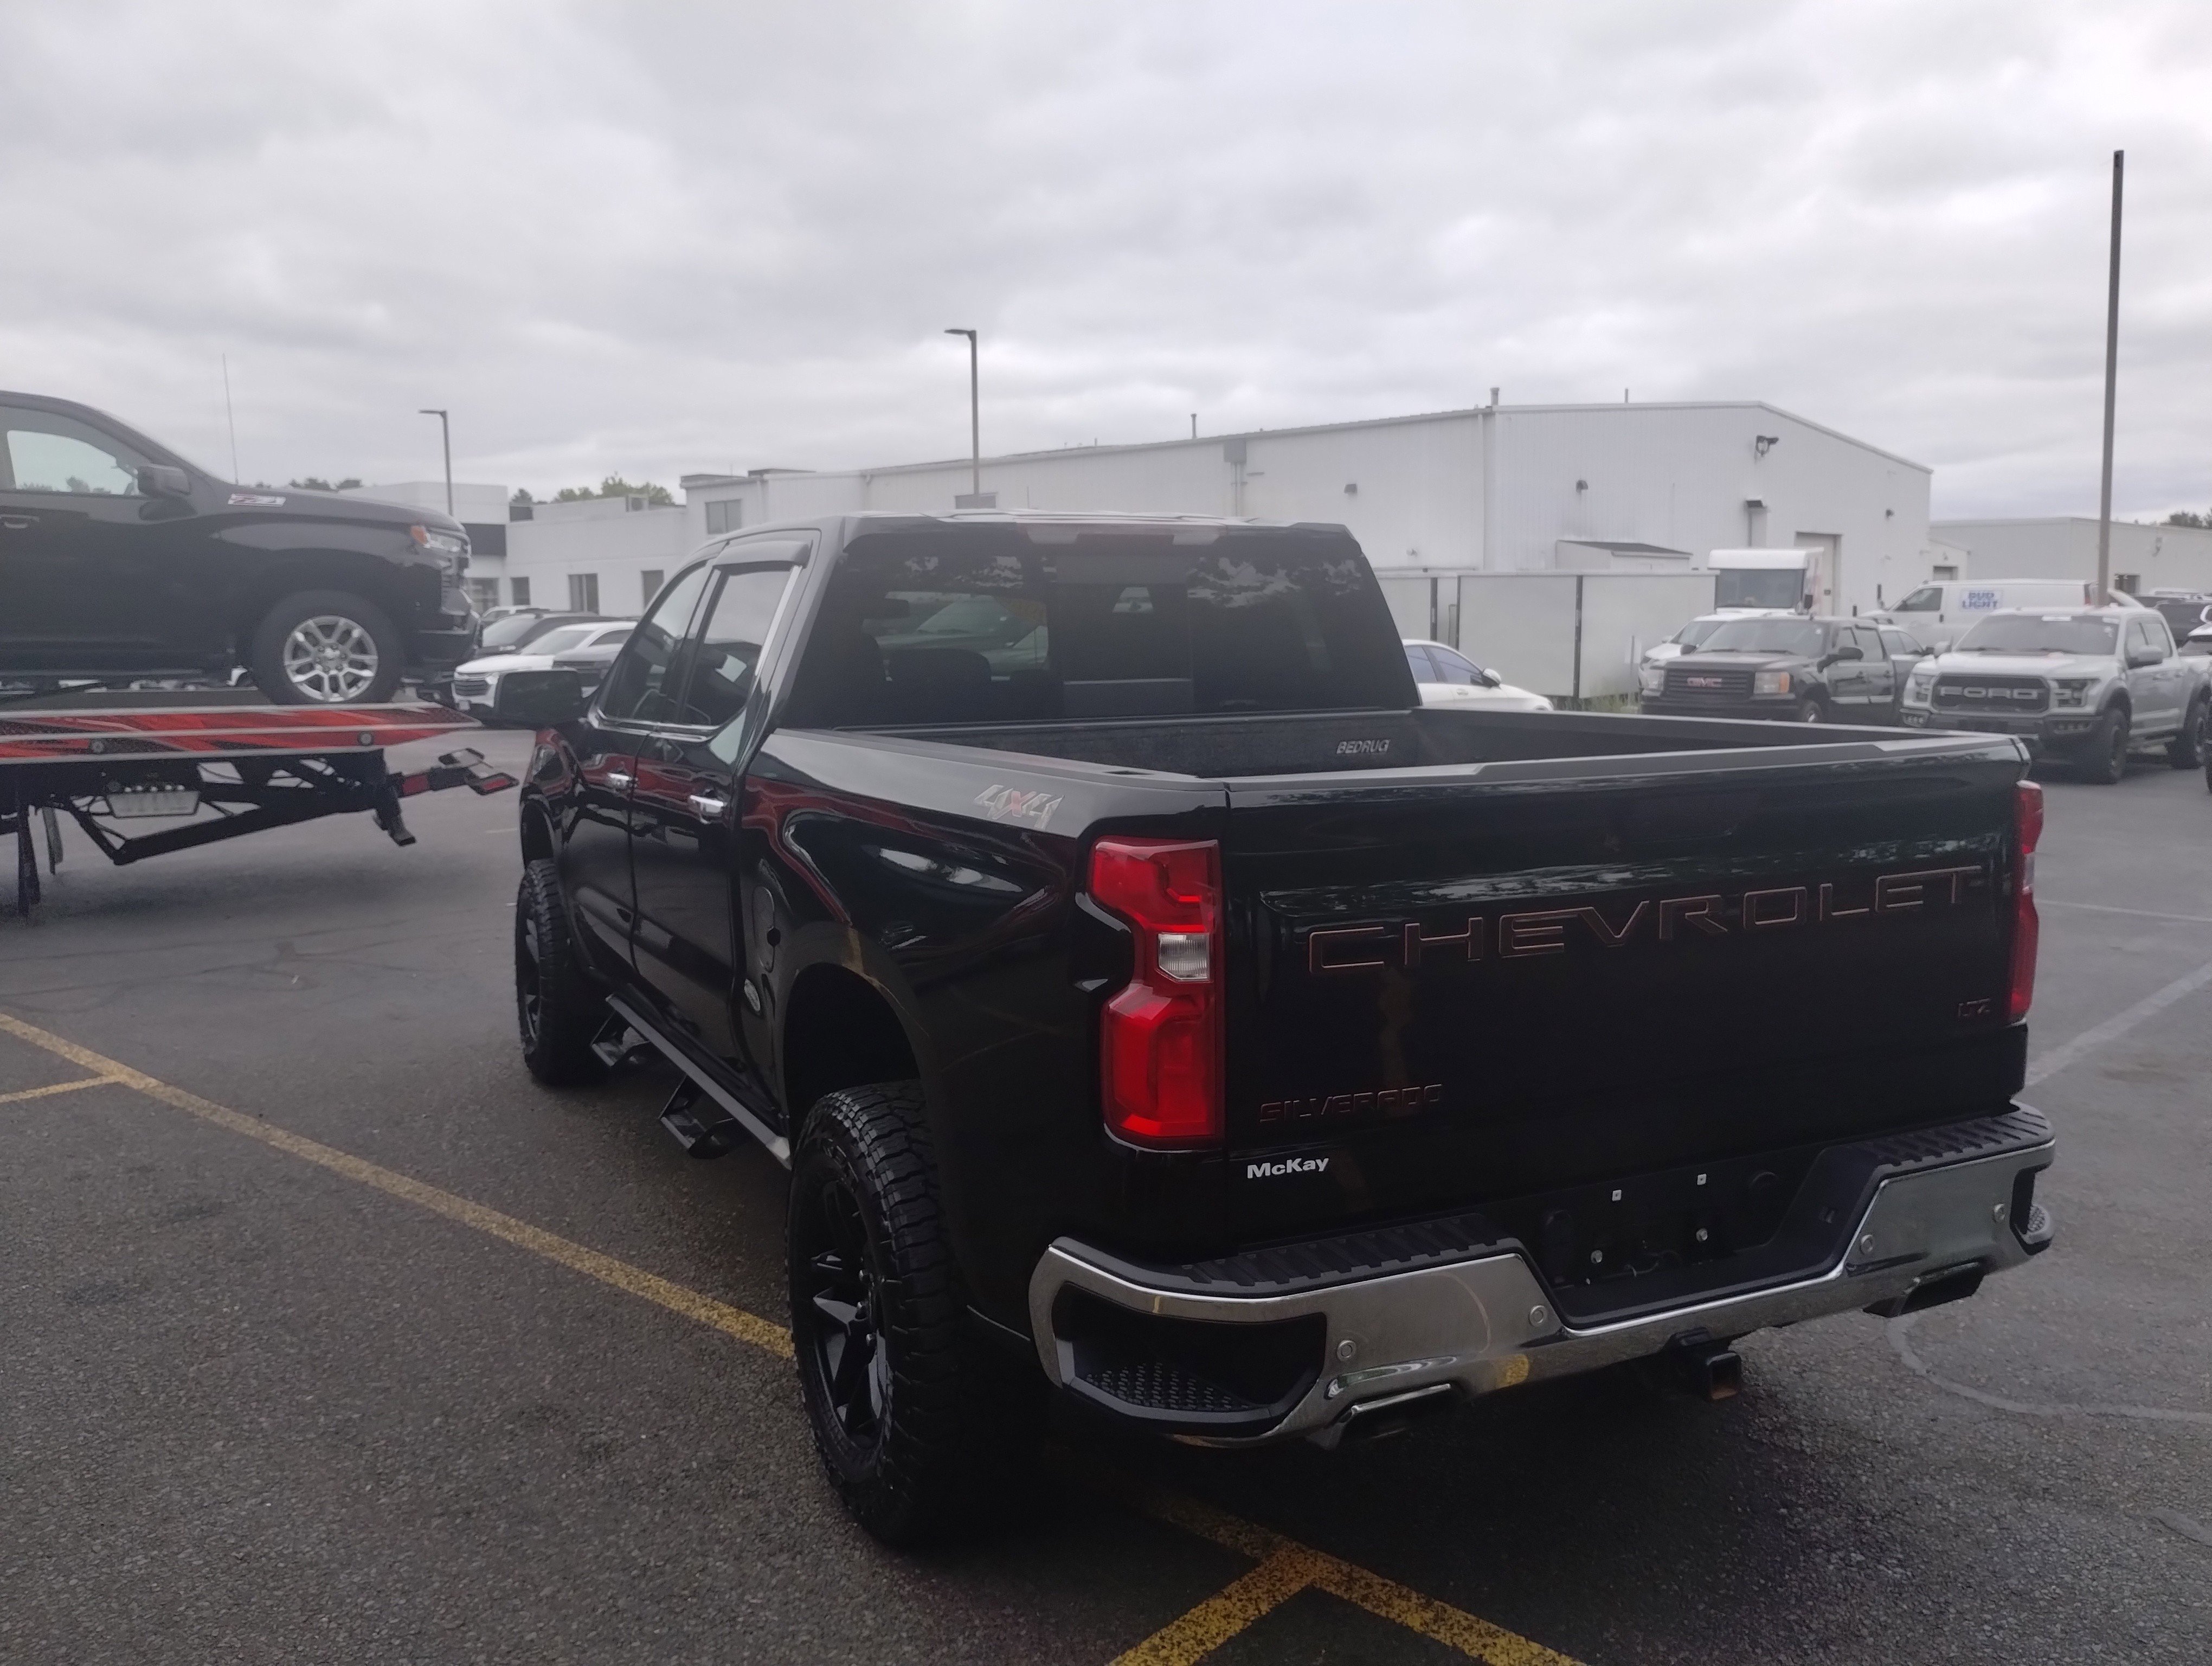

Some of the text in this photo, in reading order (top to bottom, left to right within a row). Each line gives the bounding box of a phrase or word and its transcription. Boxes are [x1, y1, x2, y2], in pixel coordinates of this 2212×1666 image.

[1968, 592, 1995, 601] BUD
[1687, 677, 1722, 688] GMC
[1940, 686, 2037, 700] FORD
[1336, 739, 1391, 754] BEDRUG
[1309, 866, 1982, 974] CHEVROLET
[1260, 1084, 1442, 1123] SILVERADO
[1247, 1157, 1329, 1178] McKay
